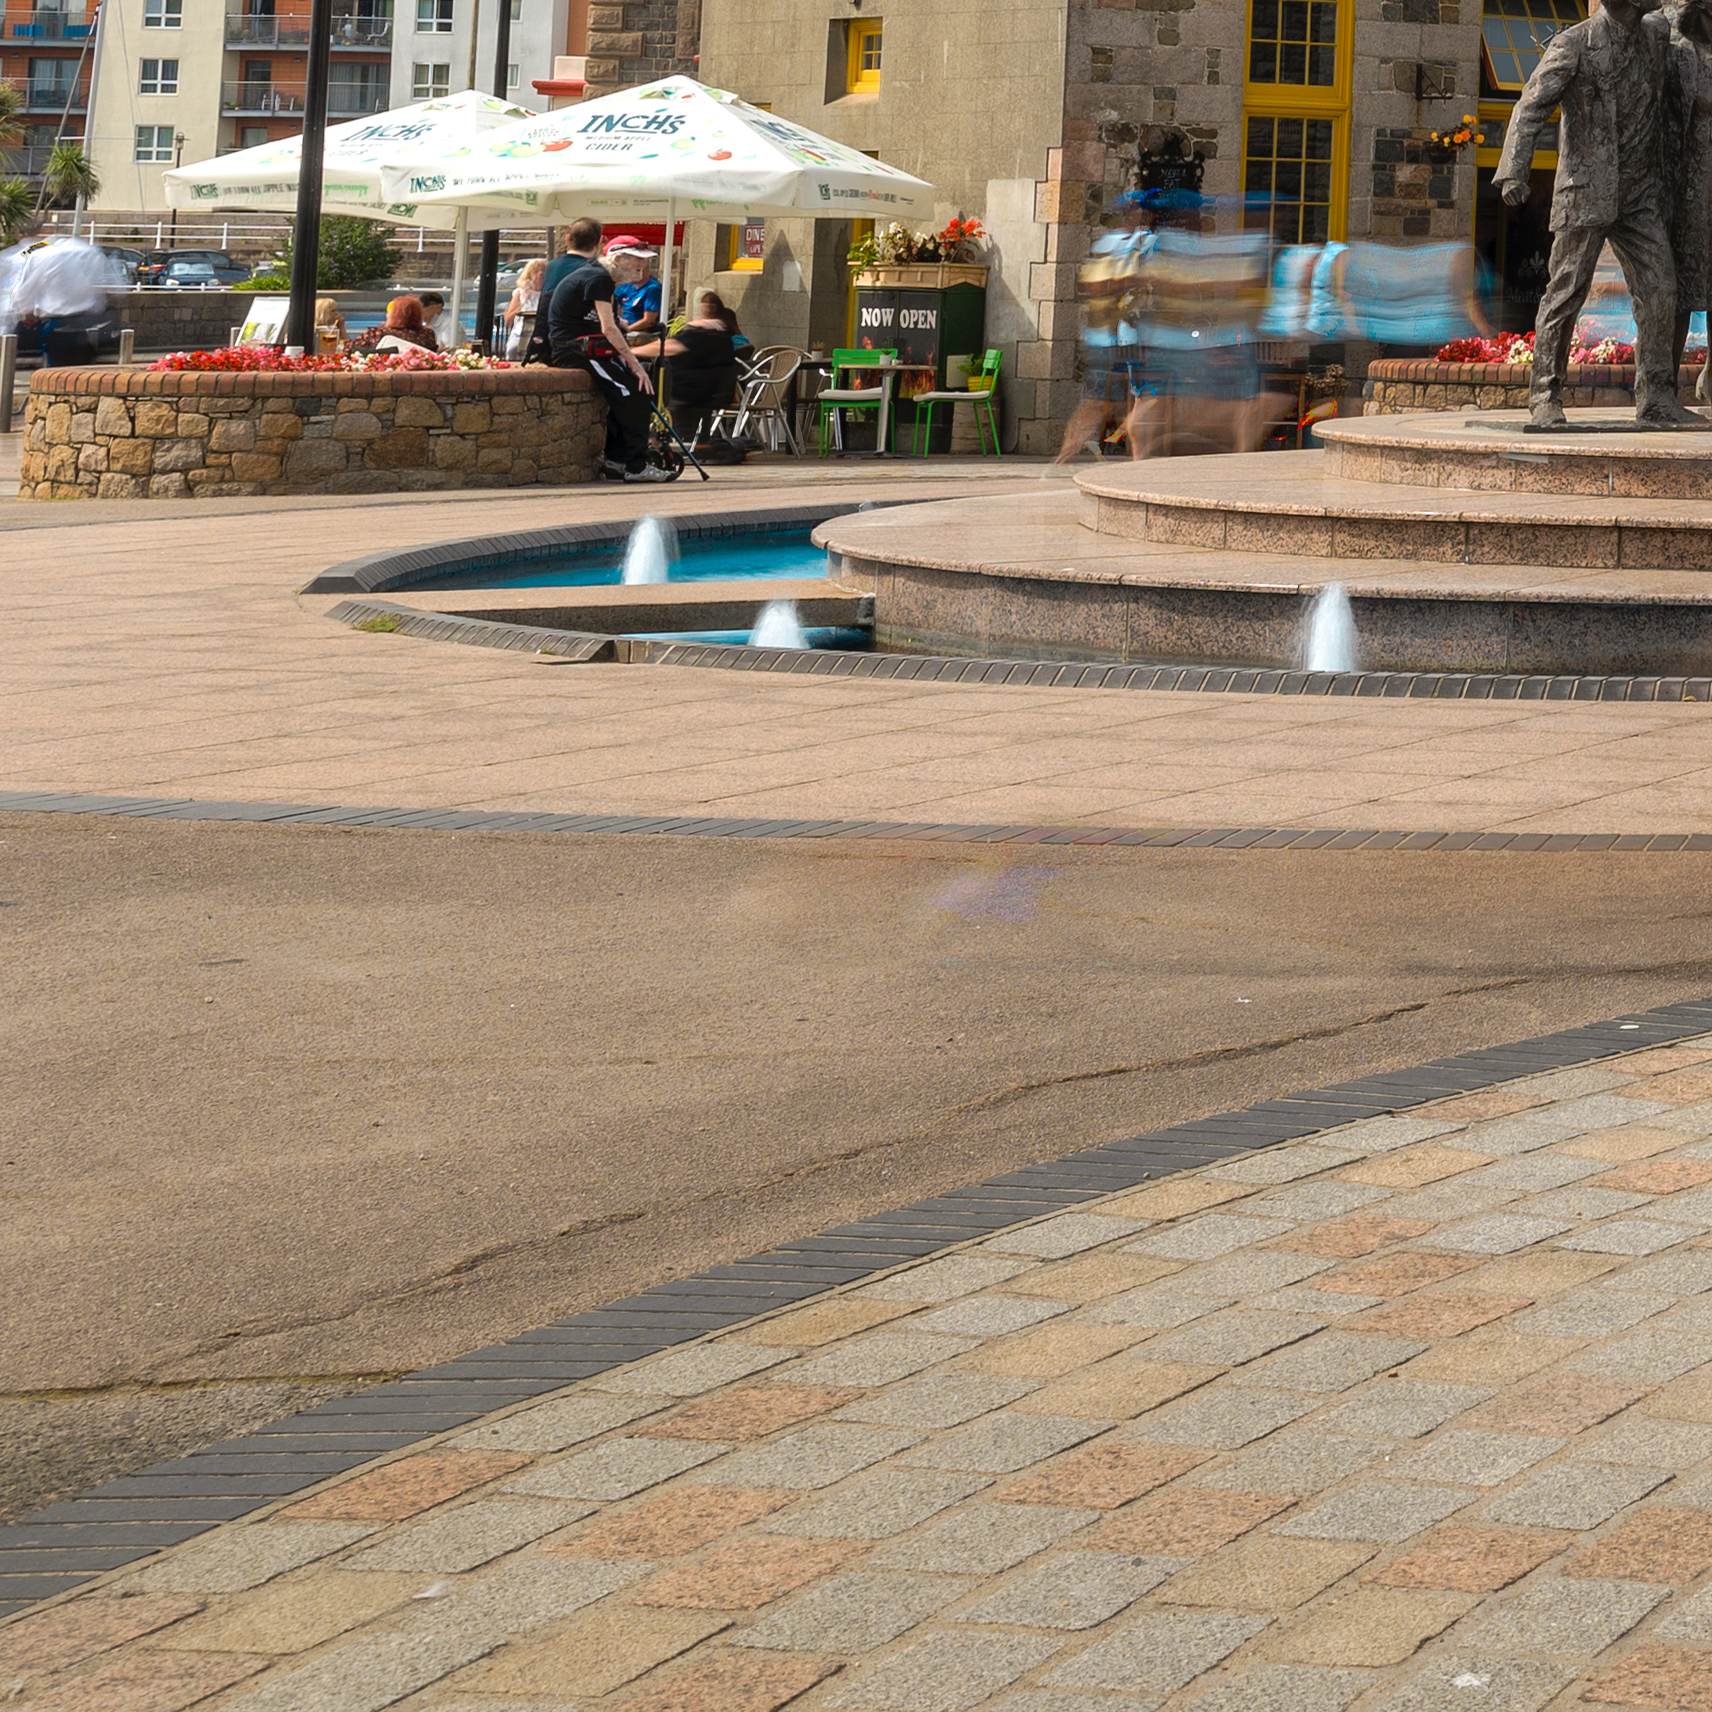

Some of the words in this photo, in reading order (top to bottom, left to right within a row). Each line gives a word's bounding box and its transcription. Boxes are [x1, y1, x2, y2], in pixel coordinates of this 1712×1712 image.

[585, 143, 634, 151] CIDER
[860, 307, 895, 328] NOW
[900, 308, 937, 329] OPEN
